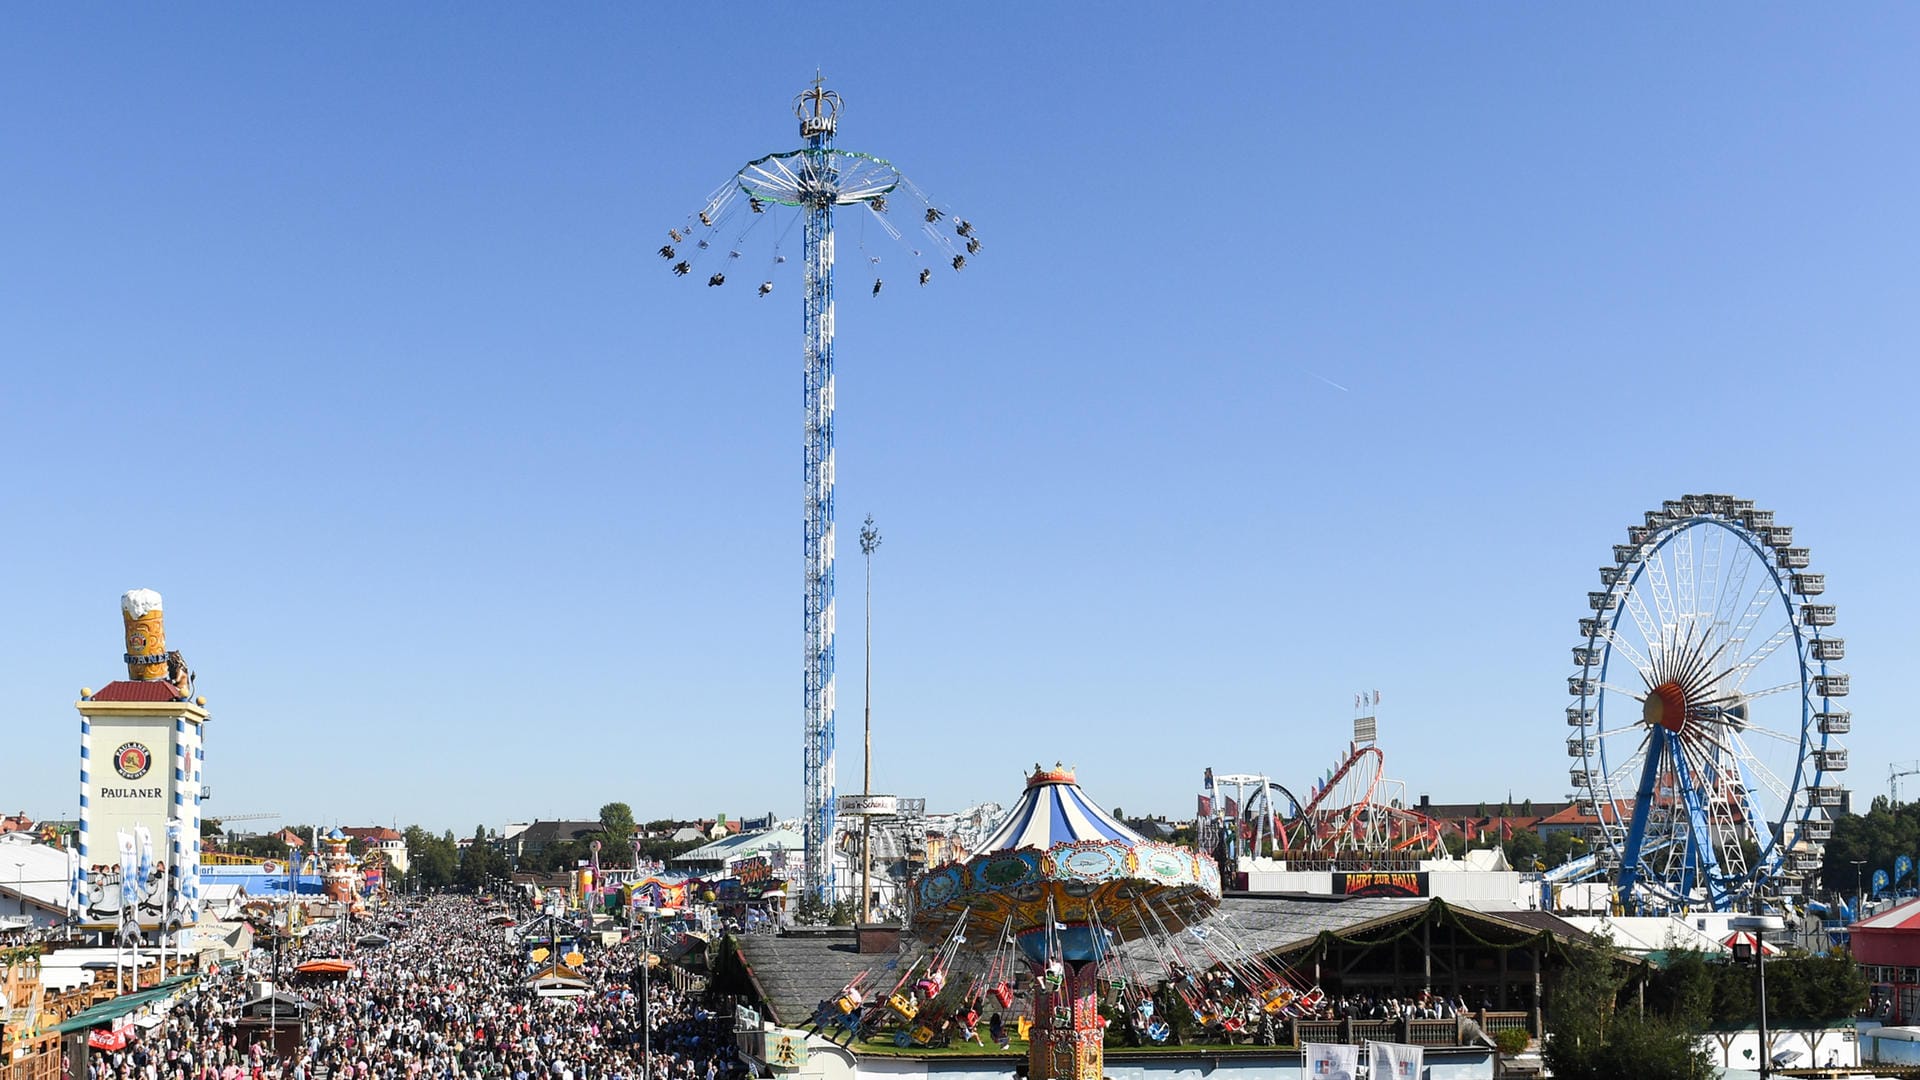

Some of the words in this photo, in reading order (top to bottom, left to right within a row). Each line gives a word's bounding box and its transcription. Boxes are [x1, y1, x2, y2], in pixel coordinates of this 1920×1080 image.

[101, 788, 162, 798] PAULANER
[1345, 873, 1373, 895] FAHRT
[1374, 874, 1391, 885] ZUR
